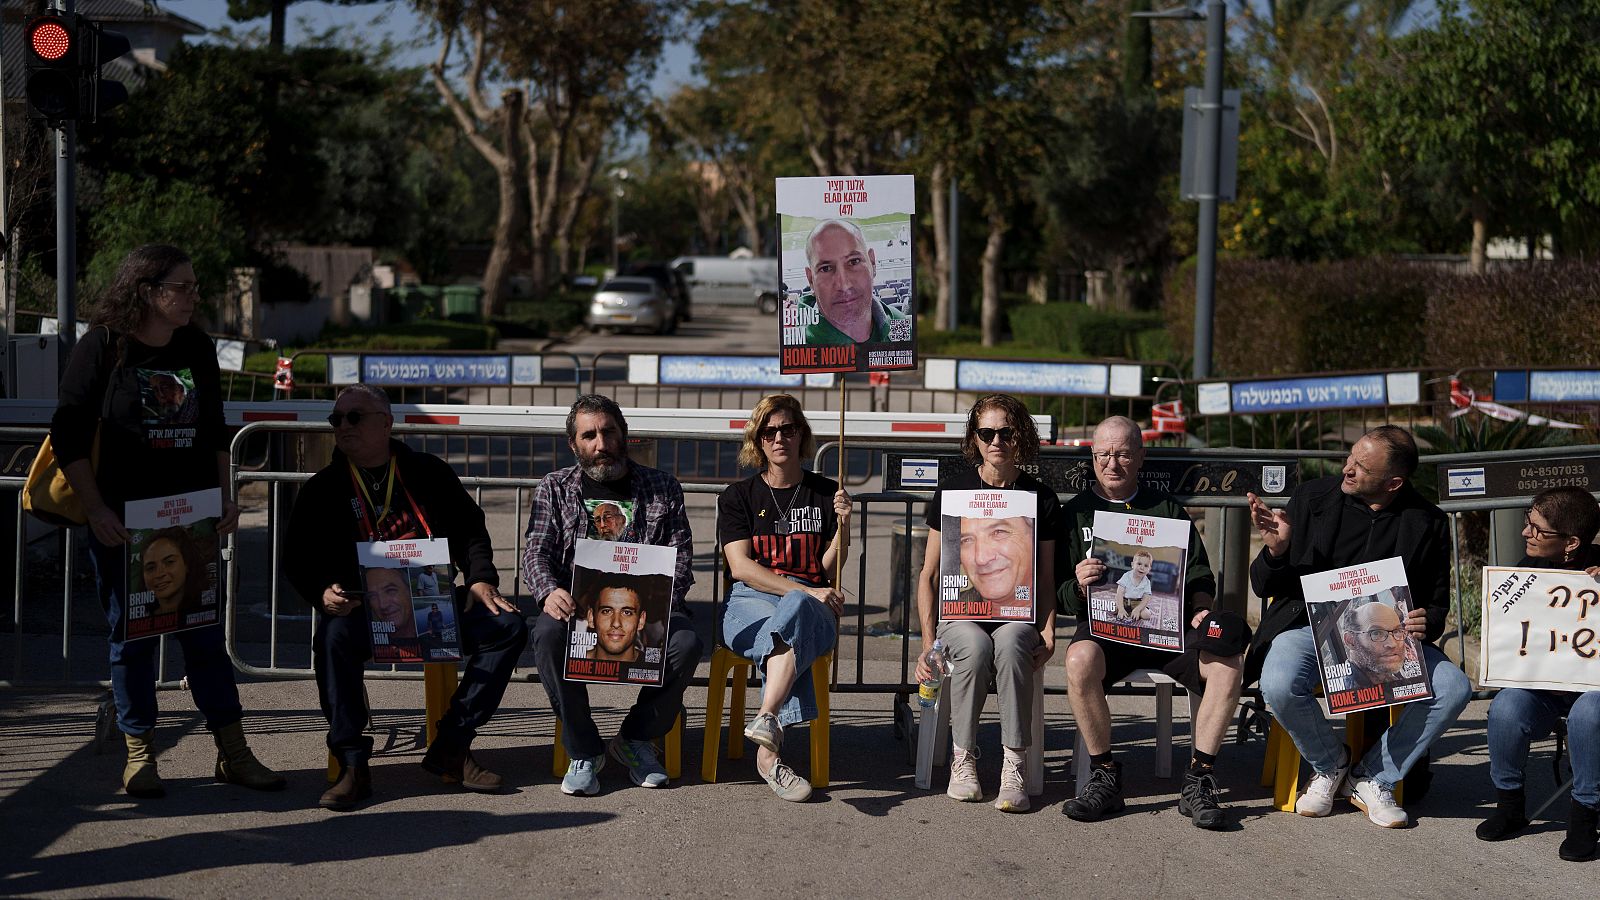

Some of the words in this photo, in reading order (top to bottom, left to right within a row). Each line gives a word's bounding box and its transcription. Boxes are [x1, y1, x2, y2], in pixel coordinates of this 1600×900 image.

[827, 180, 844, 192] קציר
[846, 179, 865, 191] אלעד
[824, 192, 842, 203] ELAD
[843, 192, 868, 203] KATZIR
[839, 204, 853, 216] (47)
[783, 307, 820, 326] BRING
[783, 326, 807, 345] HIM
[783, 347, 818, 366] HOME
[821, 344, 856, 365] NOW!
[868, 357, 893, 367] FAMILIES
[893, 356, 913, 366] FORUM
[369, 361, 430, 379] הממשלה
[434, 364, 465, 379] ראש
[469, 364, 507, 379] משרד
[1240, 387, 1302, 406] הממשלה
[1307, 386, 1338, 402] ראש
[1343, 384, 1383, 400] משרד
[1520, 465, 1585, 478] 04-8507033
[1125, 526, 1139, 535] ARIEL
[613, 554, 630, 563] DANIEL
[943, 575, 968, 588] BRING
[1329, 581, 1347, 591] NADAV
[1347, 574, 1381, 588] POPPLEWELL
[129, 590, 155, 606] BRING
[942, 588, 959, 601] HIM
[129, 605, 146, 620] HER
[942, 601, 966, 615] HOME
[967, 600, 992, 615] NOW!
[1091, 599, 1116, 612] BRING
[1091, 610, 1107, 622] HIM
[371, 621, 396, 633] BRING
[1092, 620, 1116, 634] HOME
[1117, 624, 1141, 640] NOW!
[373, 633, 390, 645] HIM
[571, 631, 598, 646] BRING
[569, 645, 587, 659] HIM
[568, 660, 593, 674] HOME
[594, 661, 620, 676] NOW!
[1324, 659, 1352, 680] BRING
[1327, 676, 1346, 693] HIM
[1330, 691, 1357, 708] HOME
[1357, 683, 1385, 703] NOW!
